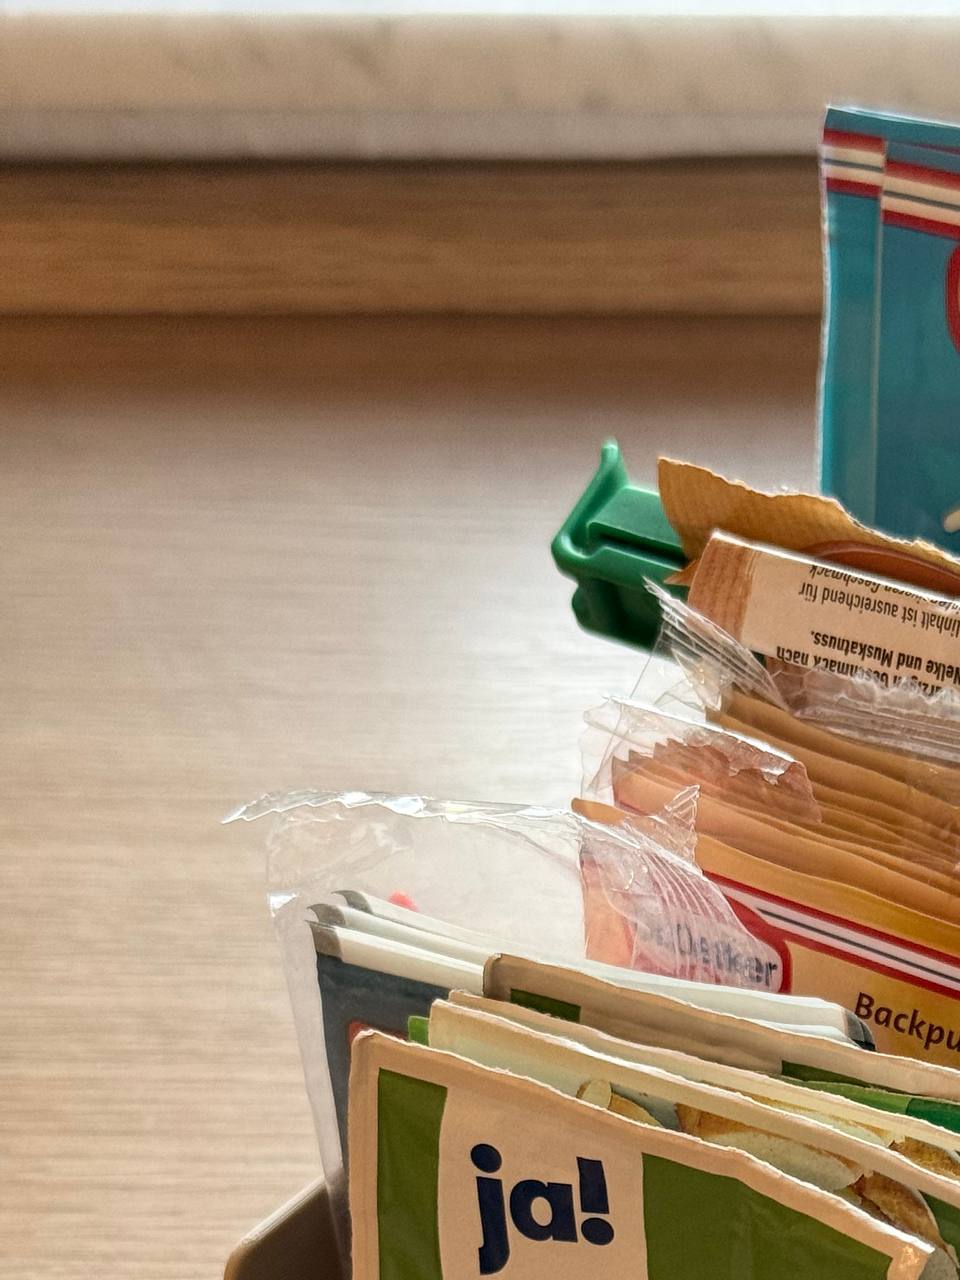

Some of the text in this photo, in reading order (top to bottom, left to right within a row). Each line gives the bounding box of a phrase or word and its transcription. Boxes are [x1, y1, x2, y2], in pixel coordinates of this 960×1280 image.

[798, 582, 819, 604] für
[821, 587, 898, 617] ausreichend
[900, 606, 918, 628] ist
[775, 646, 810, 668] nach
[810, 630, 893, 667] Muskatnuss.
[897, 653, 922, 673] und
[470, 1143, 615, 1275] ja!
